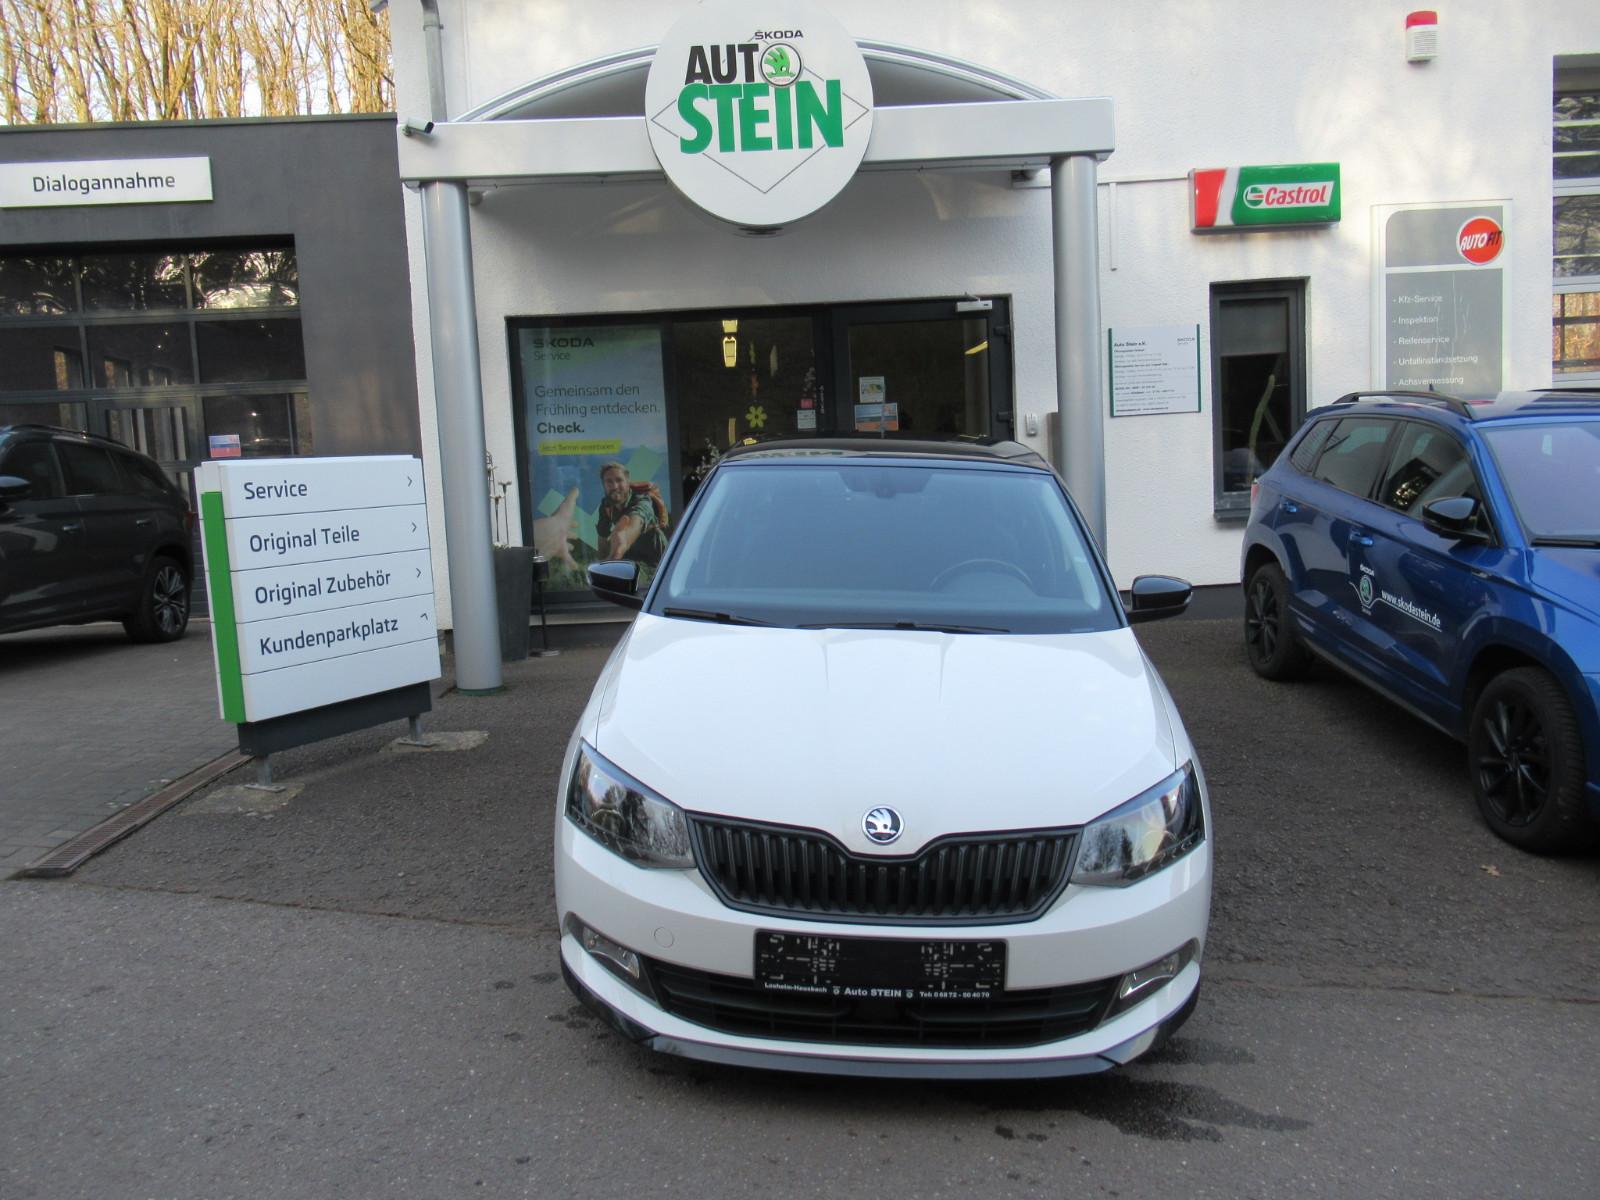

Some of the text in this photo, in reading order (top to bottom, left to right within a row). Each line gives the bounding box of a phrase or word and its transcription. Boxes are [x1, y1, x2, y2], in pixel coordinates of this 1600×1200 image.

[677, 79, 844, 155] STEIN
[32, 172, 176, 195] Dialogannahme
[1265, 184, 1327, 207] Castrol
[1398, 315, 1439, 326] Inspektion
[1398, 335, 1450, 345] Reifenservice
[534, 383, 640, 398] Gemeinsam den
[1398, 375, 1464, 386] Achsvermessung
[535, 401, 661, 418] Frühling entdecken.
[536, 421, 585, 434] Check.
[243, 480, 308, 500] Service
[249, 525, 360, 555] Original Teile
[255, 570, 391, 606] Original Zubehör
[1381, 590, 1441, 628] www.skodastein.de
[260, 618, 399, 656] Kundenparkplatz
[844, 987, 868, 997] Auto
[870, 988, 902, 998] STEIN
